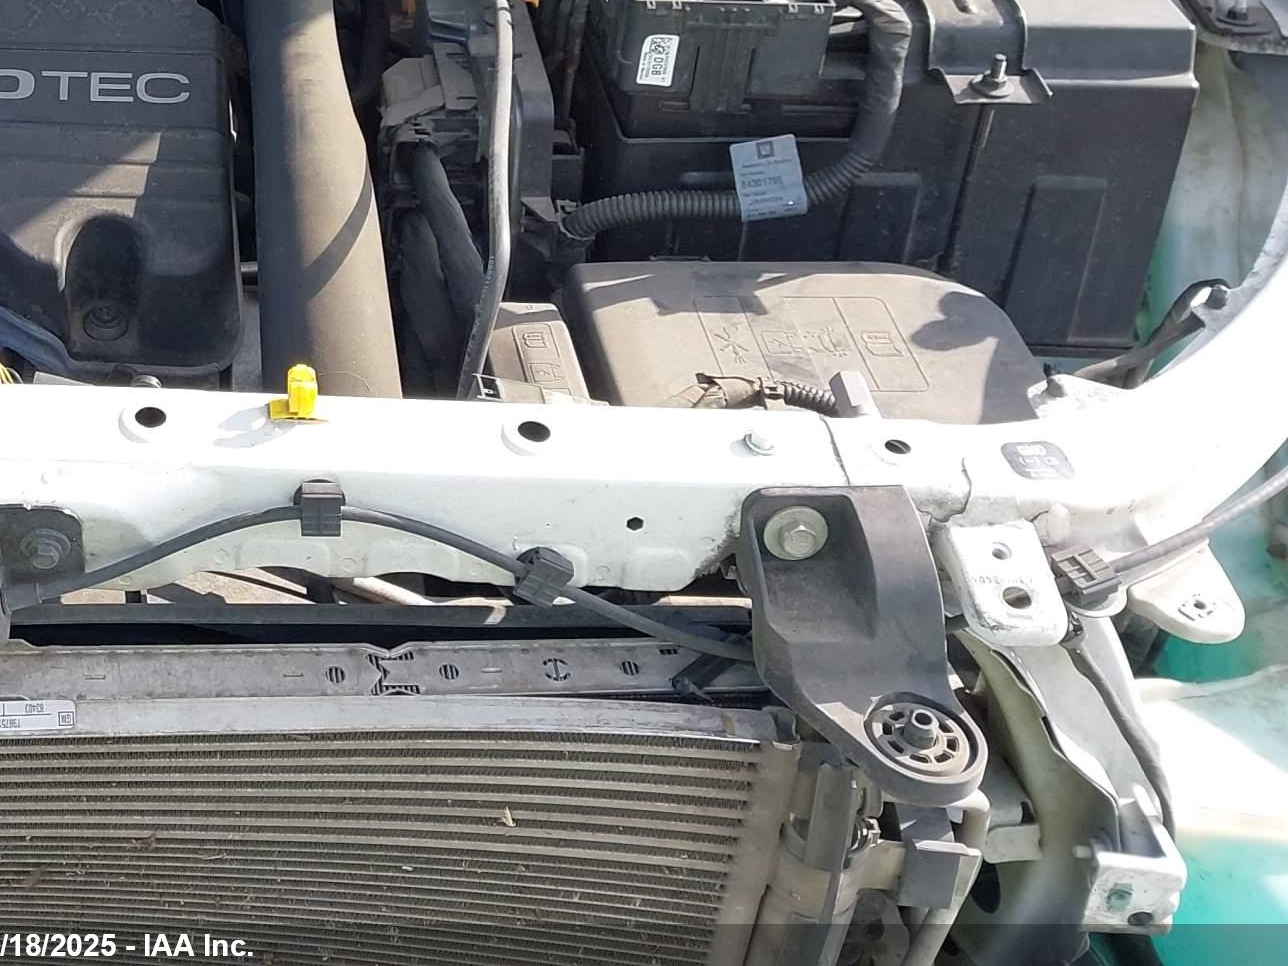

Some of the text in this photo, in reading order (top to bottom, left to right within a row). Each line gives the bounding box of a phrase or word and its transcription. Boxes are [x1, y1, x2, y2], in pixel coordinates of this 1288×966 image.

[651, 57, 664, 75] DGB
[24, 703, 44, 713] 83403
[61, 713, 72, 724] GM
